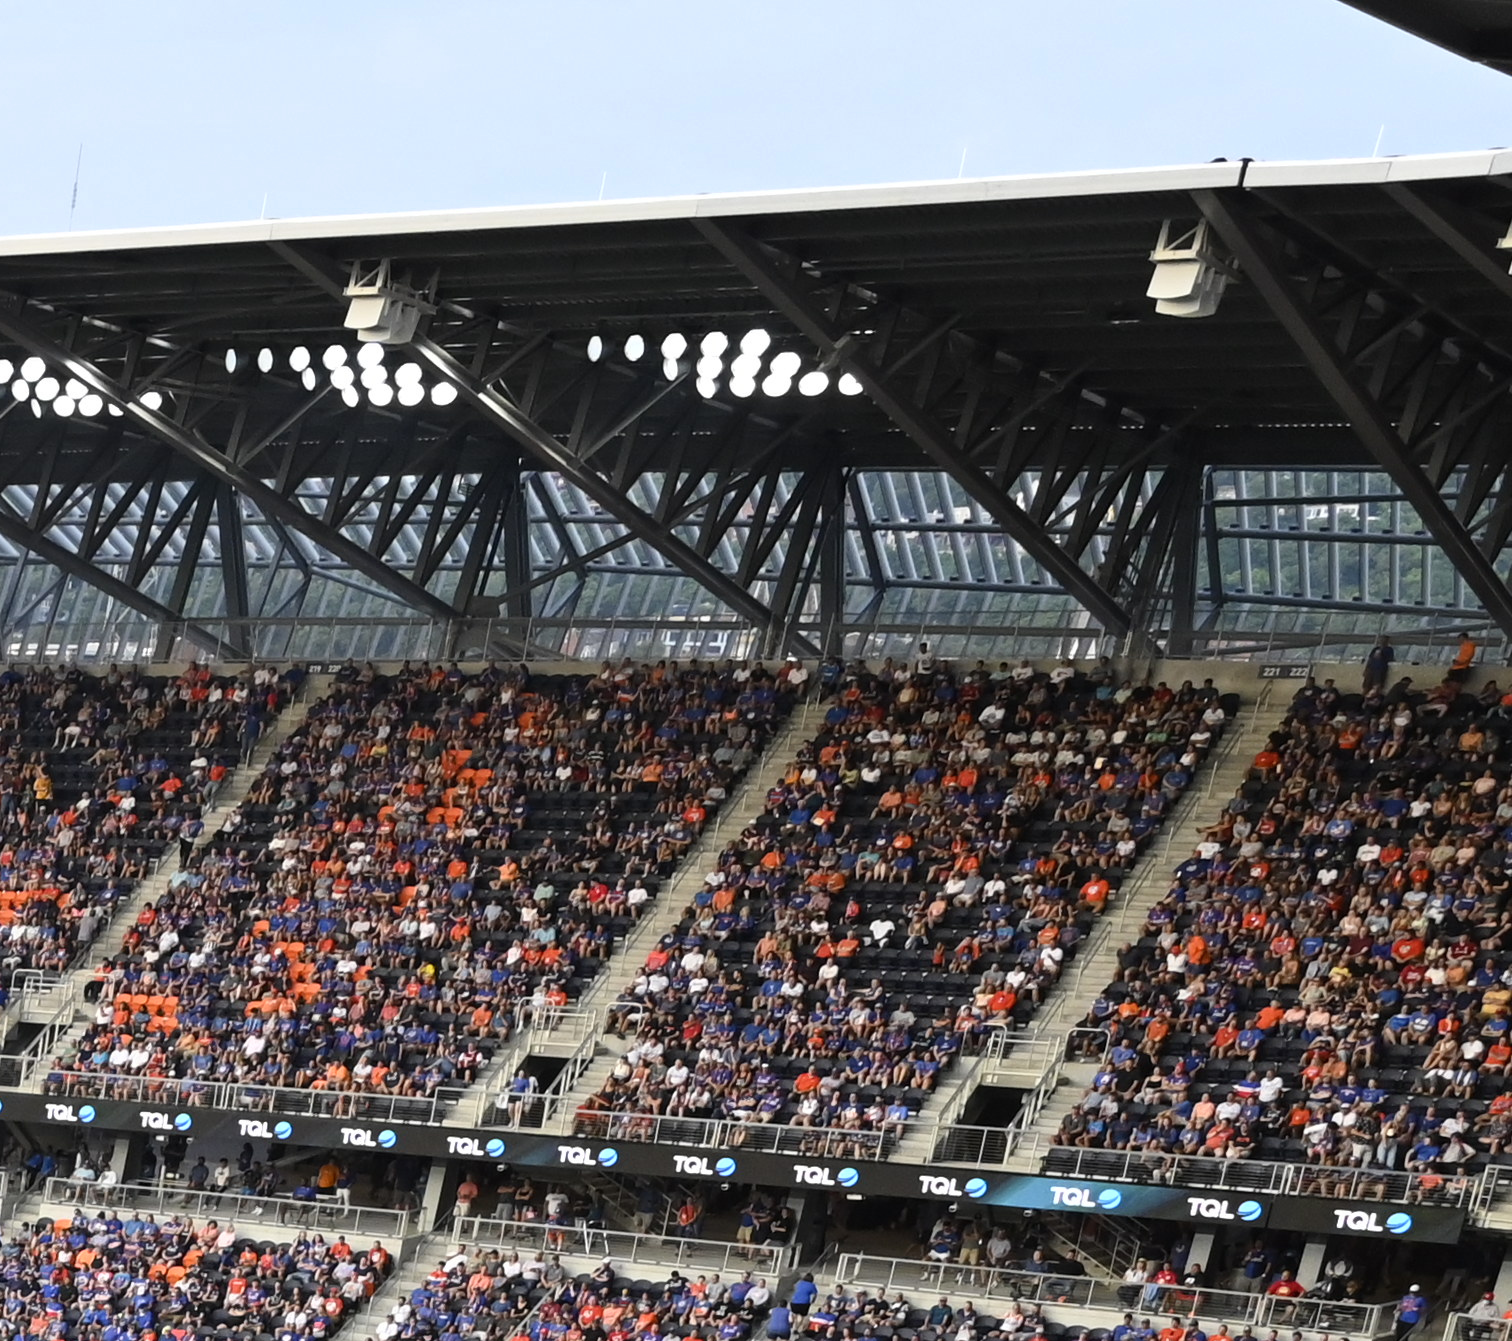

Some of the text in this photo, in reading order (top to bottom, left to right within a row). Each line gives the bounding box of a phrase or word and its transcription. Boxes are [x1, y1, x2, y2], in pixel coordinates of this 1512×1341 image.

[44, 1104, 78, 1121] TQL
[139, 1112, 174, 1129] TQL
[237, 1120, 274, 1138] TQL
[340, 1128, 377, 1147] TQL
[446, 1137, 485, 1156] TQL
[557, 1146, 597, 1165] TQL
[672, 1155, 714, 1175] TQL
[793, 1165, 836, 1185] TQL
[918, 1176, 963, 1196] TQL
[1049, 1186, 1097, 1207] TQL
[1187, 1198, 1235, 1219] TQL
[1333, 1210, 1384, 1232] TQL
